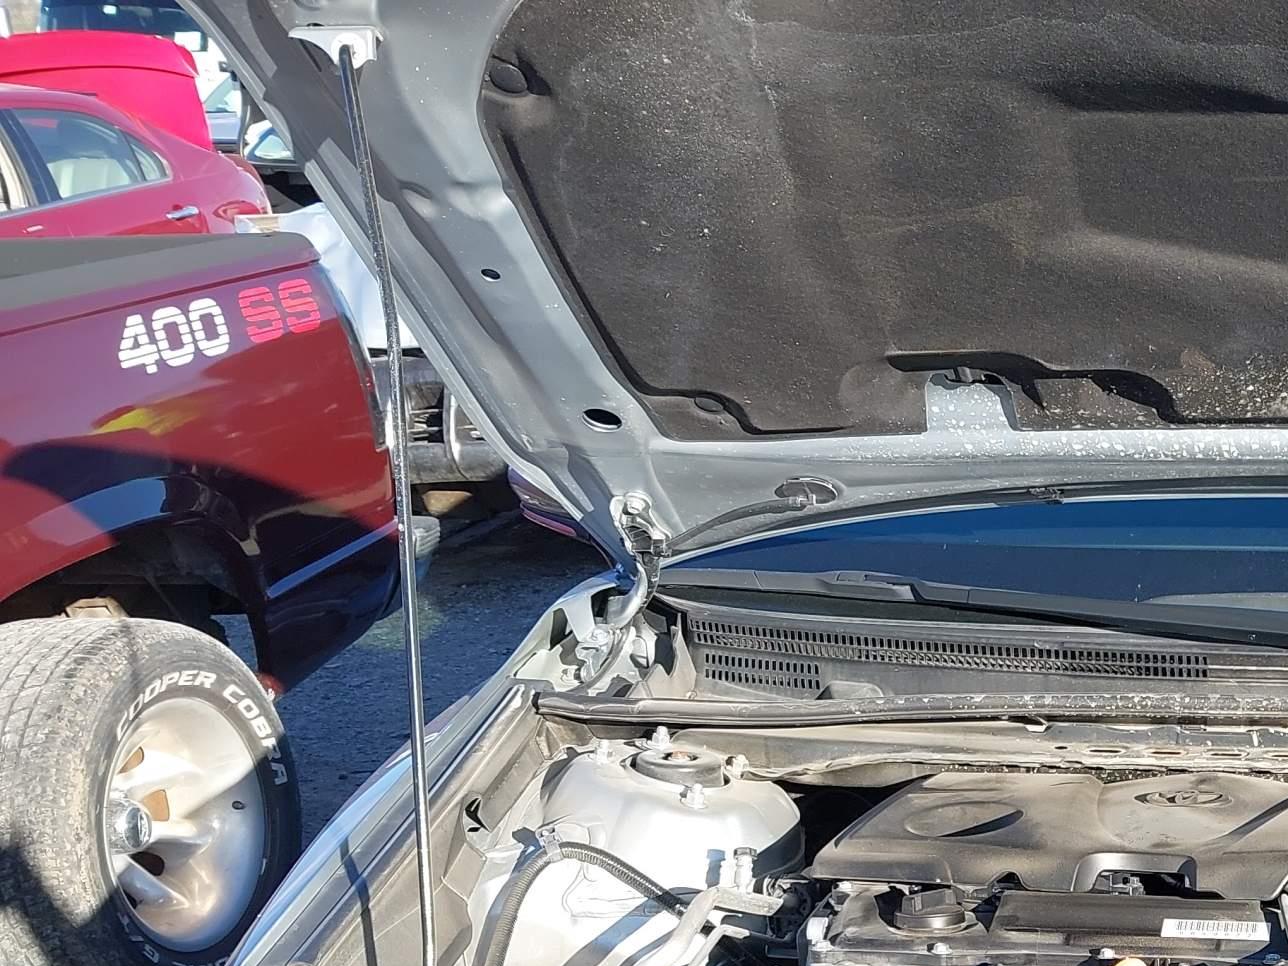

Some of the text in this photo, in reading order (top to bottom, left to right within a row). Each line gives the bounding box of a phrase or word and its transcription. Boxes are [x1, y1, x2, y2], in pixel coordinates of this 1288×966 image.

[118, 278, 321, 374] 400 SS
[117, 670, 288, 785] COOPER COBRA
